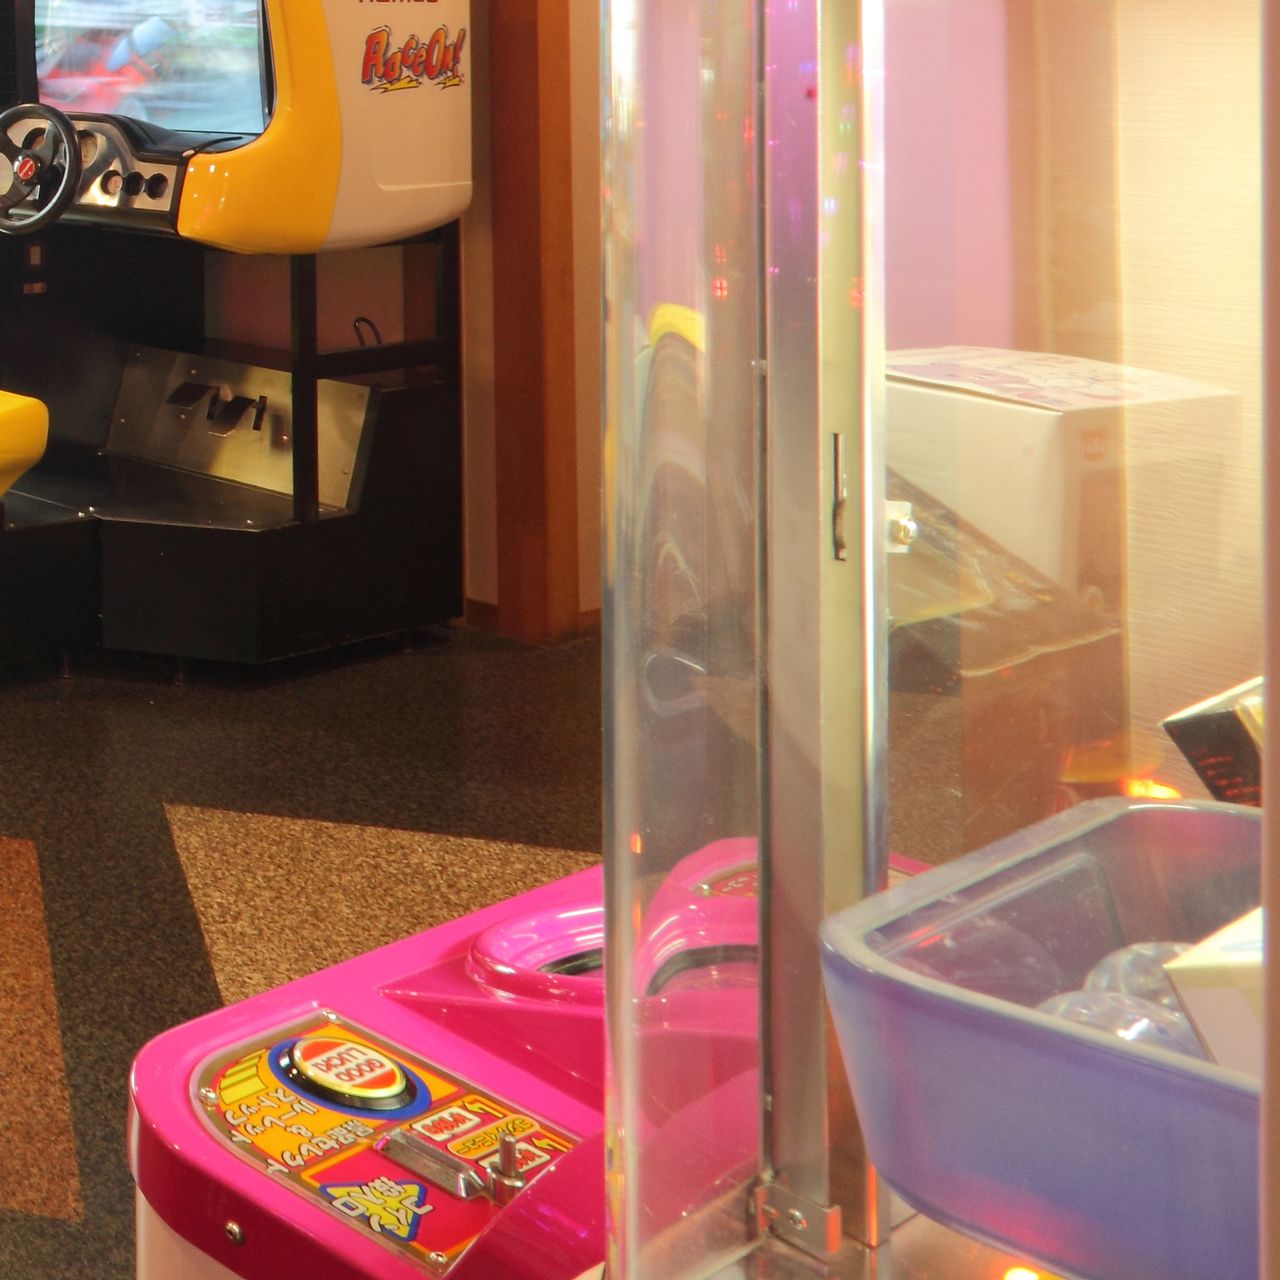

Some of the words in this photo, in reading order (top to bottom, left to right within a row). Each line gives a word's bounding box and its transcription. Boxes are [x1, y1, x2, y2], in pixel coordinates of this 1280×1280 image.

[334, 1058, 384, 1084] GOOD
[331, 1175, 406, 1217] 投入口
[368, 1197, 434, 1233] コイン
